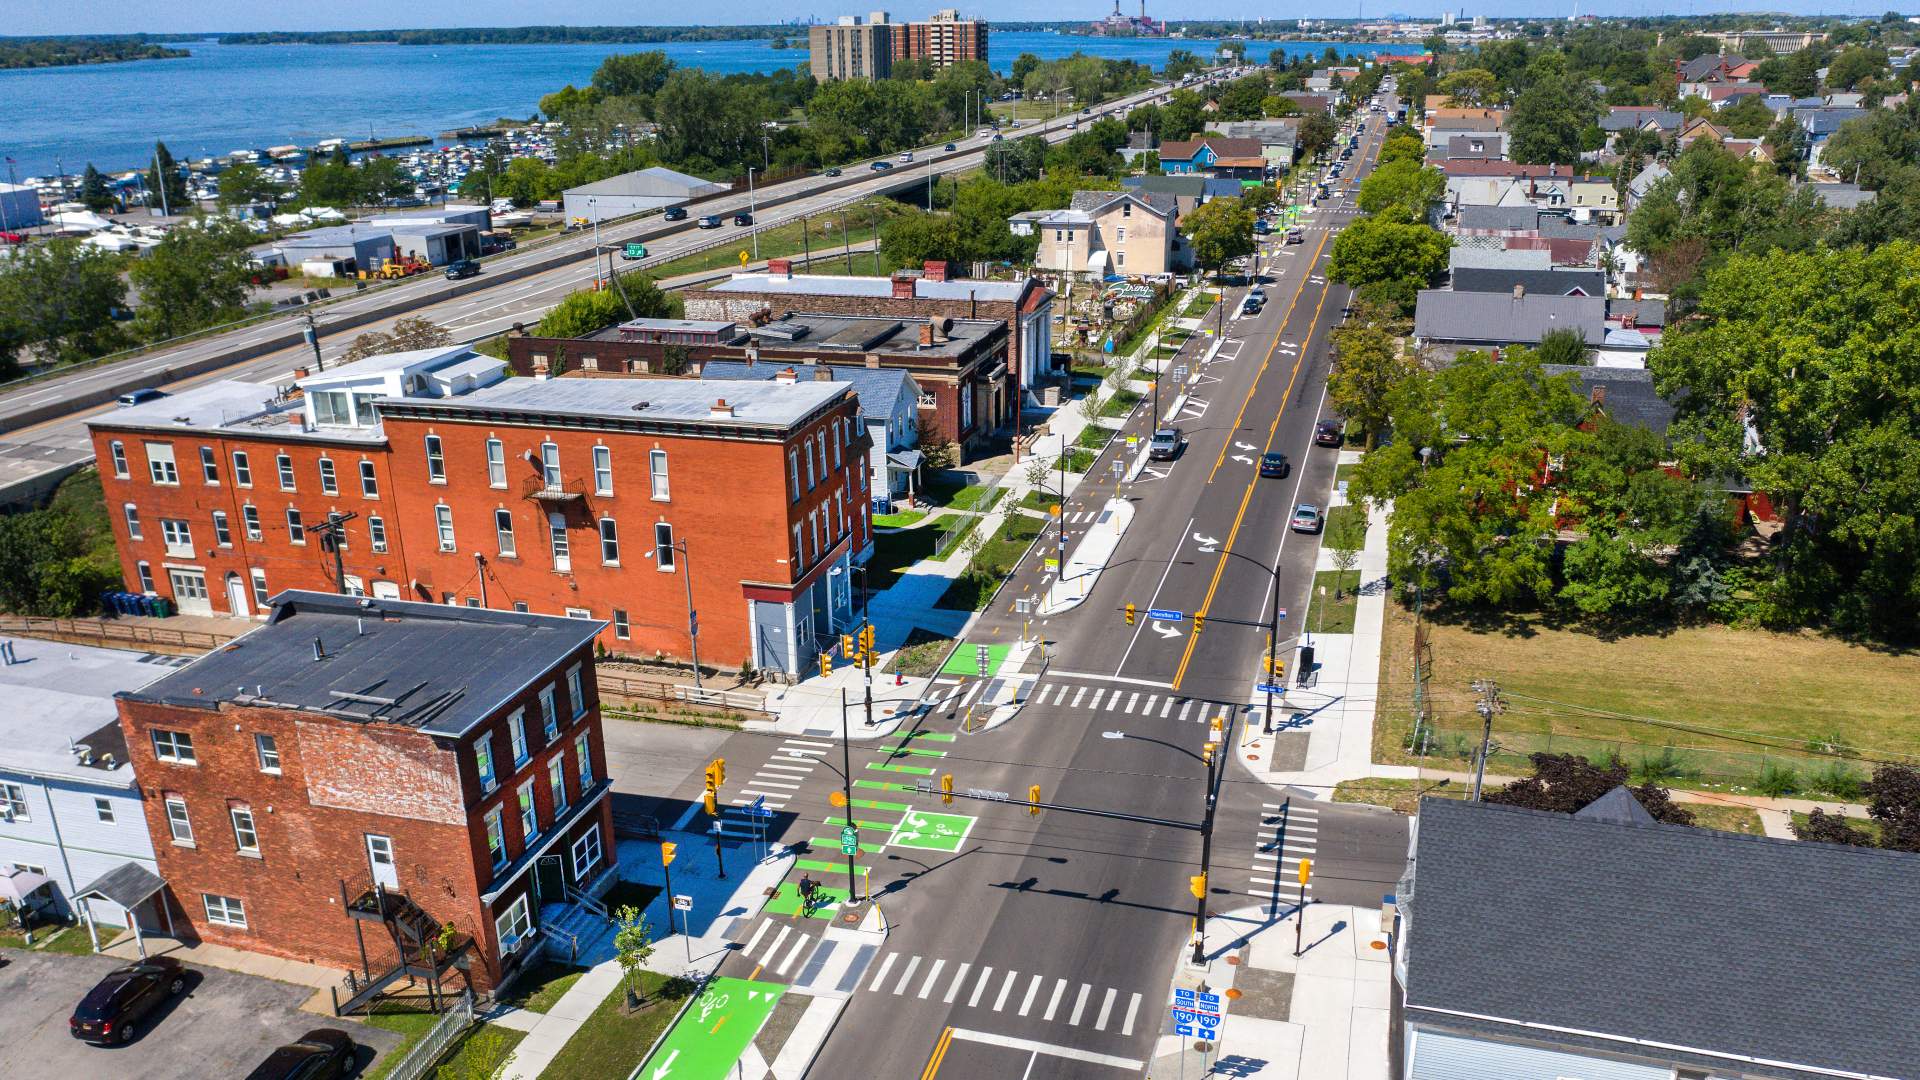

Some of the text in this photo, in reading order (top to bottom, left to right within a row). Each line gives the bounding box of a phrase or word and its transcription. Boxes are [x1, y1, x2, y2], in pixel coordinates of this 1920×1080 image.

[1176, 998, 1194, 1007] SOUTH
[1200, 1002, 1218, 1012] NORTH
[1175, 1011, 1193, 1022] 190
[1200, 1015, 1217, 1026] 190
